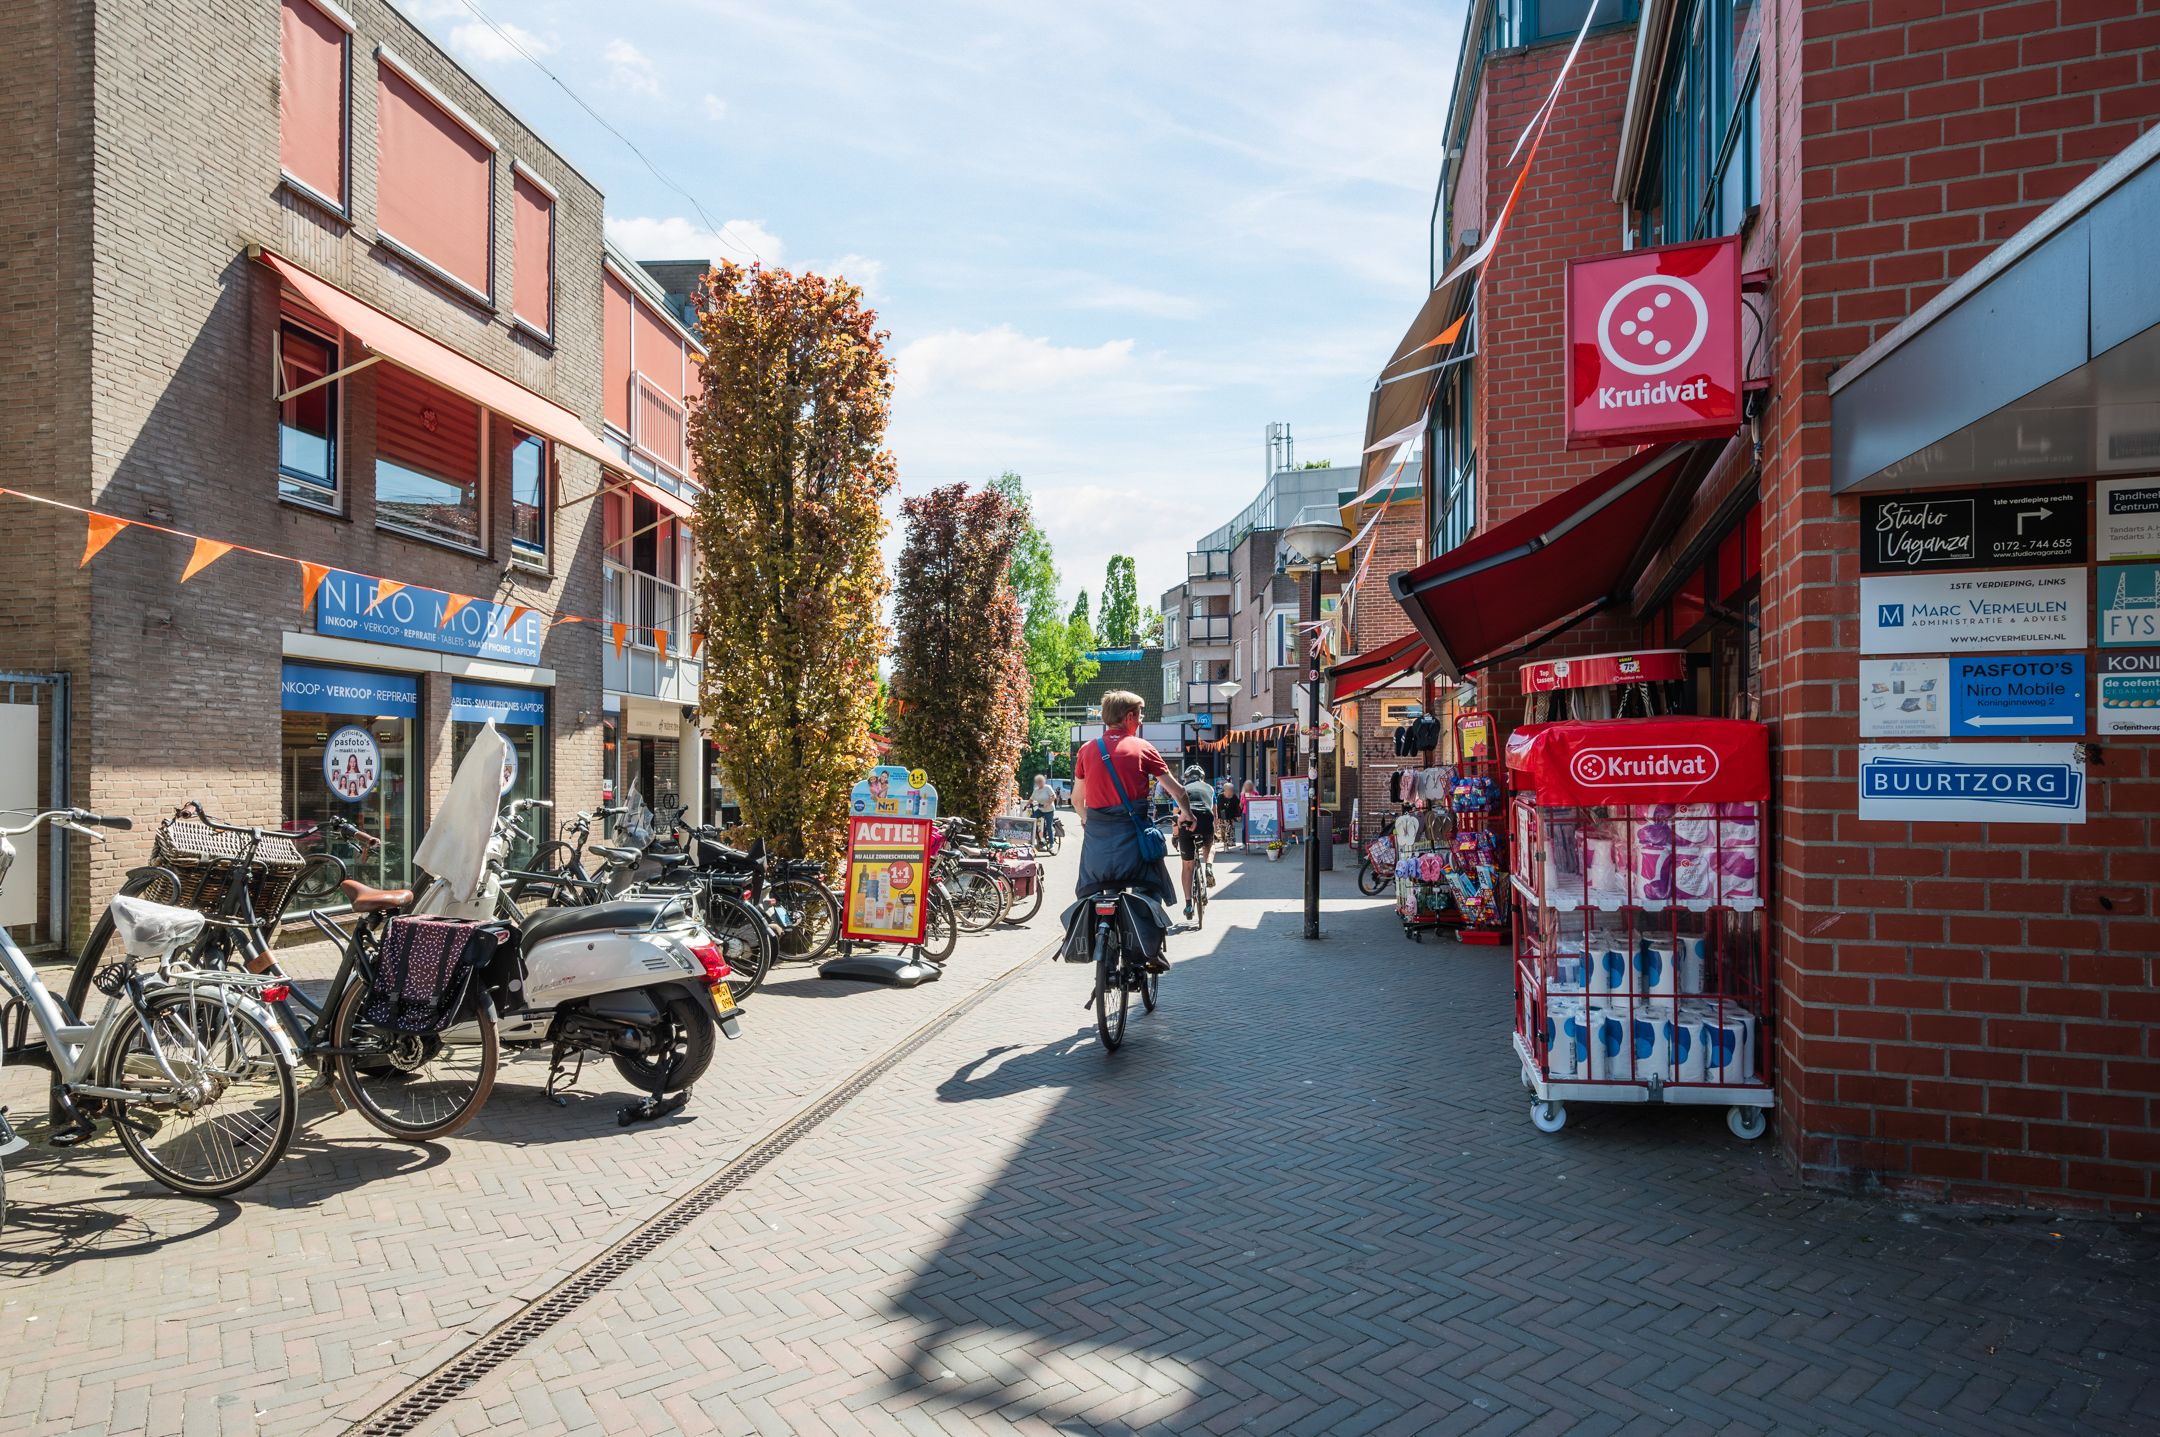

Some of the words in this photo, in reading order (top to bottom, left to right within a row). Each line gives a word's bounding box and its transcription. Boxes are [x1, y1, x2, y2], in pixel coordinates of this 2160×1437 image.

[1599, 378, 1708, 409] Kruidvat
[2010, 496, 2049, 505] verdieping
[2050, 494, 2073, 503] rechts
[2113, 502, 2158, 511] Centrum
[1876, 502, 1948, 531] Studio
[2109, 525, 2145, 533] Tandarts
[2109, 533, 2145, 541] Tandarts
[1888, 531, 1970, 565] Vaganza
[1993, 541, 2020, 551] 0172
[2030, 539, 2049, 549] 744
[2052, 538, 2072, 548] 655
[1993, 548, 2072, 558] www.studiovaganza.nl
[1950, 582, 1972, 590] 1STE
[1976, 580, 2035, 589] VERDIEPING,
[2038, 578, 2066, 586] LINKS
[325, 578, 414, 623] NIRO
[434, 600, 537, 646] MOBILE
[1911, 617, 2003, 627] ADMINISTRATIE
[2023, 614, 2067, 623] ADVIES
[2111, 613, 2155, 636] FYS
[325, 615, 358, 629] INKOOP
[363, 622, 400, 636] VERKOOP
[404, 629, 437, 642] REPARATIE
[440, 635, 464, 647] TABLETS
[513, 647, 537, 658] LAPTOPS
[1950, 633, 2067, 643] WWW.MCVERMEULEN.NL
[2108, 655, 2160, 670] KONI
[1539, 670, 1550, 678] Top
[1962, 662, 2073, 677] PASFOTO'S
[1967, 683, 2002, 696] Niro
[2007, 681, 2065, 696] Mobile
[2105, 679, 2119, 688] de
[326, 685, 372, 699] VERKOOP
[376, 690, 417, 704] REPARATIE
[450, 696, 472, 707] ABLETS
[520, 703, 544, 713] LAPTOPS
[1977, 698, 2046, 707] Koninginneweg
[334, 737, 370, 747] pasfoto's
[1608, 754, 1706, 777] Kruidvat
[911, 773, 924, 782] 1+1
[1874, 773, 2057, 792] BUURTZORG
[878, 802, 895, 811] Nr.1
[857, 822, 919, 843] ACTIE!
[890, 866, 910, 879] 1+1
